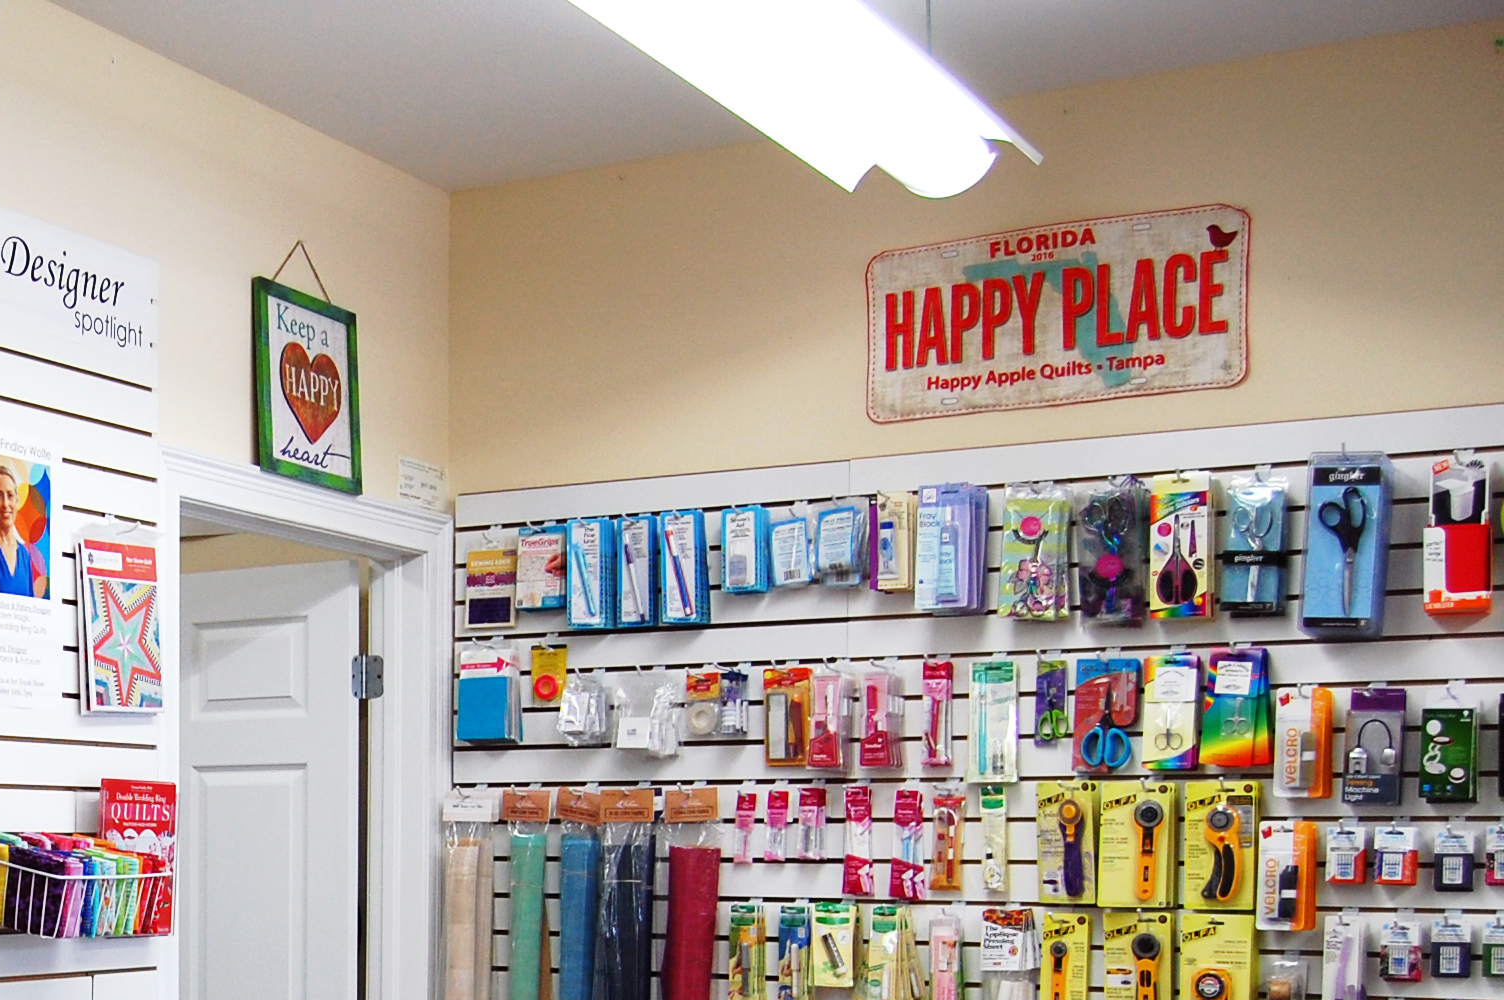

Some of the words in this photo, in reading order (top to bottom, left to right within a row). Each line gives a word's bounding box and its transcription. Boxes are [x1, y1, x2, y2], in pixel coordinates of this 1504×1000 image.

[988, 227, 1096, 259] FLORIDA
[1030, 250, 1055, 262] 2016
[0, 235, 126, 310] Designer
[884, 270, 1045, 373] HAPPY
[1061, 248, 1230, 352] PLACE
[74, 310, 144, 348] spotlight
[276, 301, 316, 350] Keep
[320, 328, 330, 348] a
[926, 371, 982, 394] Happy
[985, 366, 1036, 388] Apple
[1039, 361, 1093, 381] Quilts
[1106, 350, 1166, 374] Tampa
[284, 363, 340, 412] HAPPY
[0, 438, 28, 459] Findlay
[29, 445, 52, 461] Wolfe
[279, 435, 351, 469] heart
[919, 512, 937, 522] Fray
[520, 536, 560, 549] TrueGrips
[1344, 793, 1364, 802] Light
[1345, 786, 1380, 795] Machine
[1038, 792, 1065, 809] OLFA
[1103, 794, 1137, 811] OLFA
[1187, 795, 1221, 811] OLFA
[110, 802, 171, 824] QUILTS
[1042, 924, 1075, 941] OLFA
[1104, 923, 1137, 940] OLFA
[1182, 926, 1216, 942] OLFA
